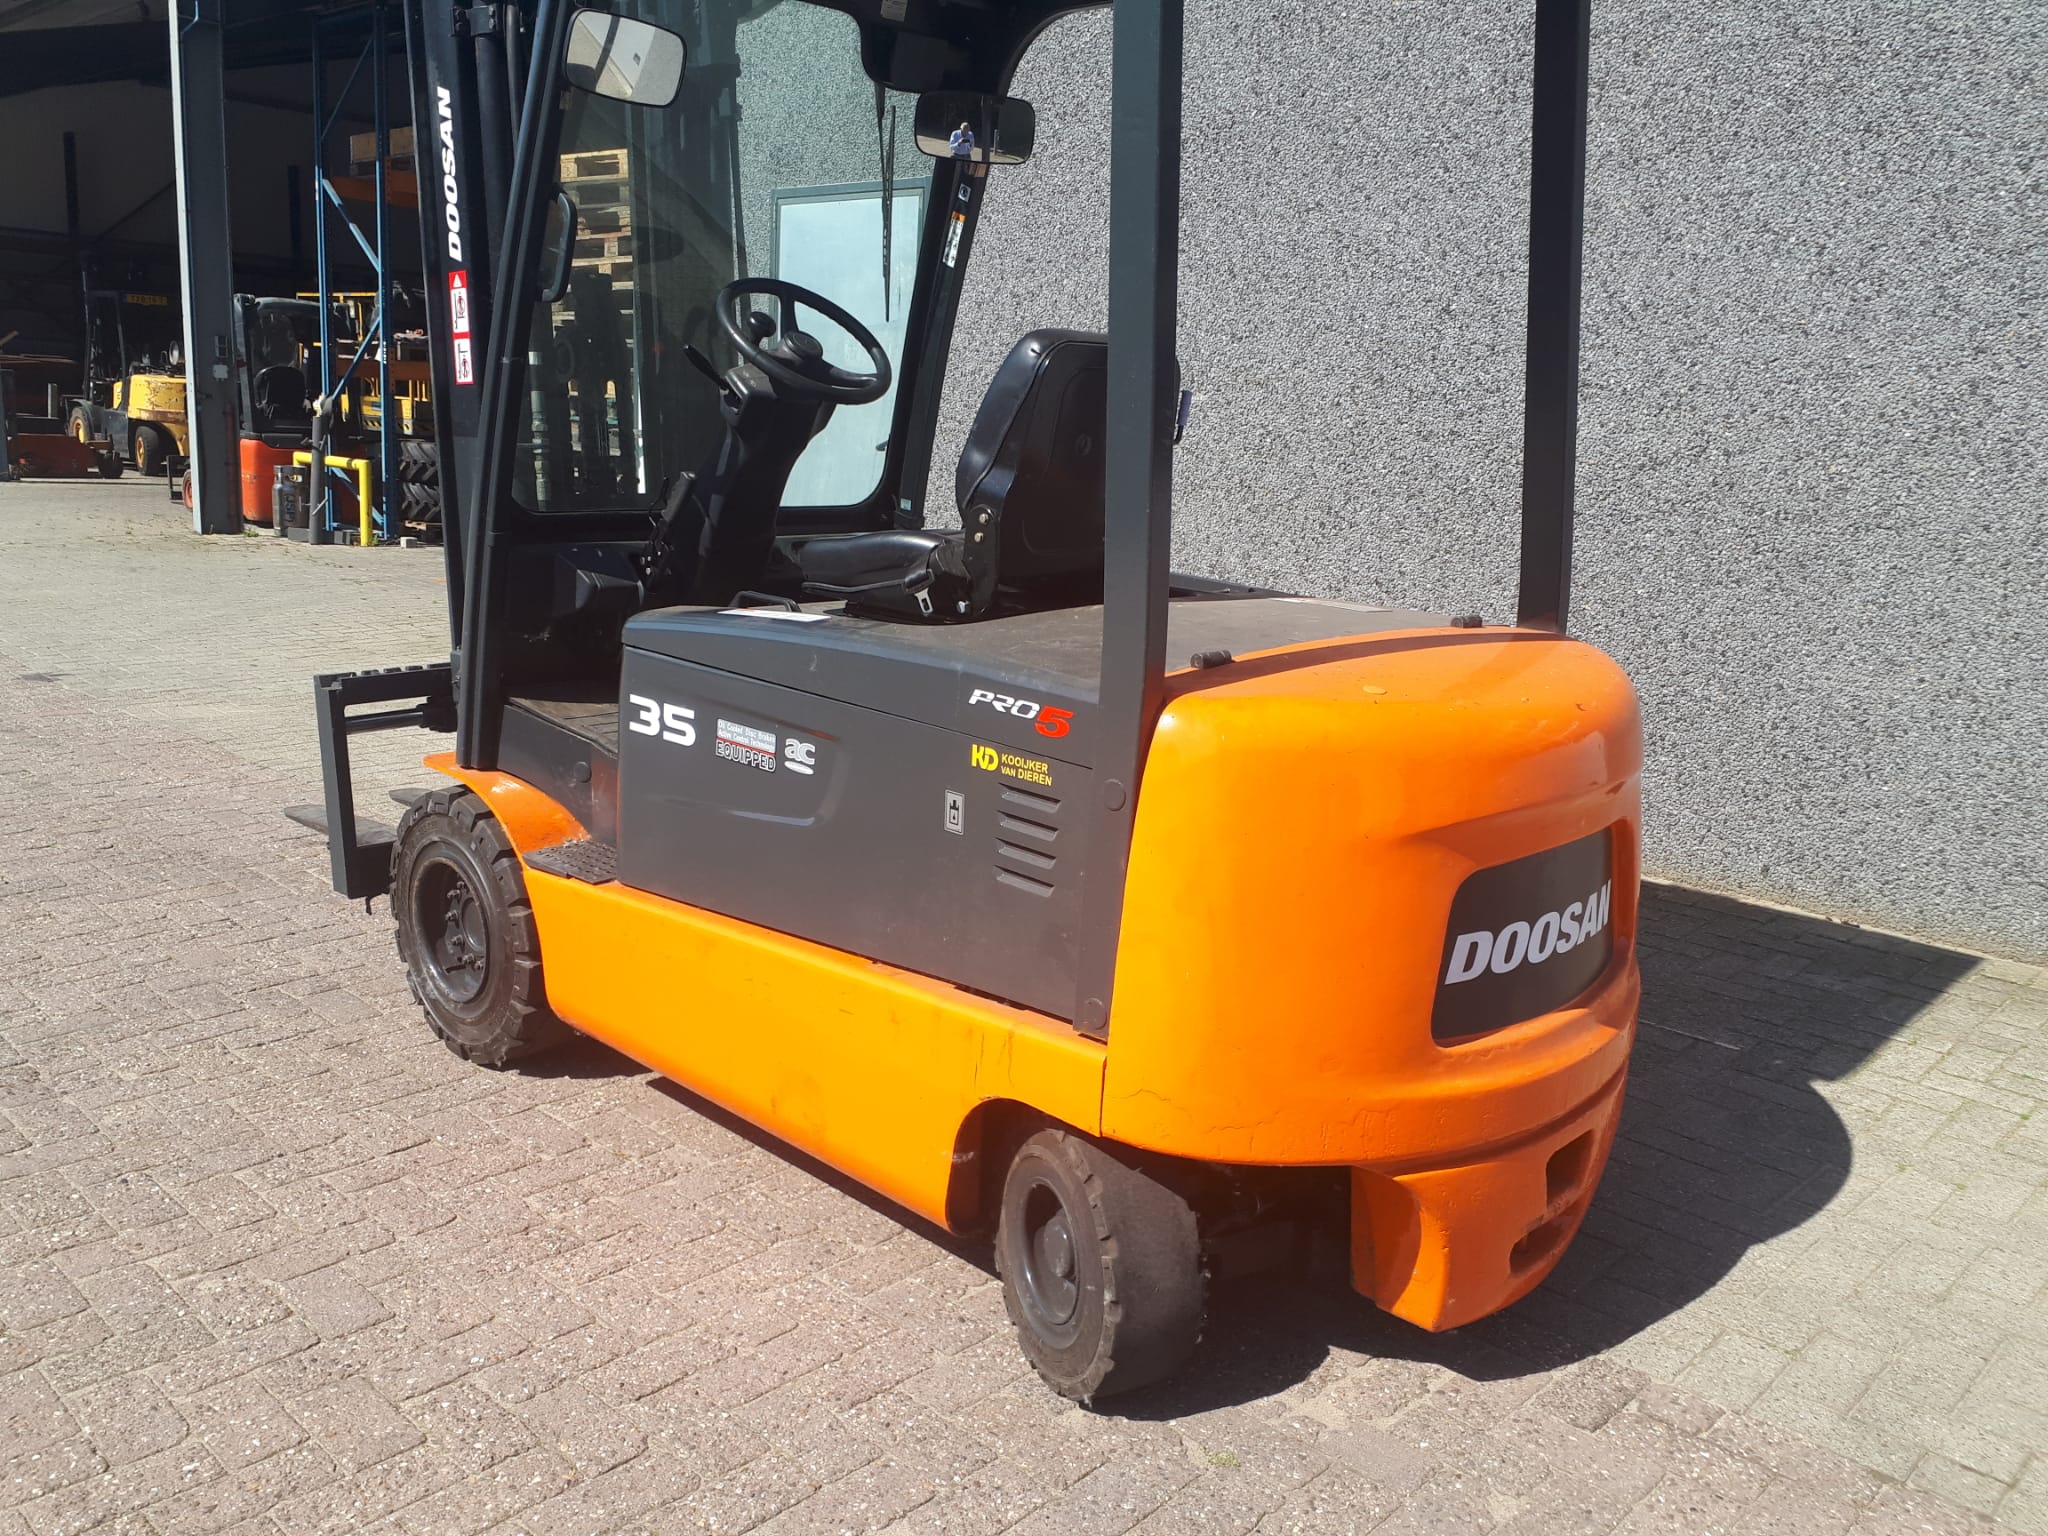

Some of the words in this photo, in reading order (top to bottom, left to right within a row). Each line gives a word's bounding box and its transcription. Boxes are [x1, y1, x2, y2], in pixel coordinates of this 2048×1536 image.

[437, 86, 462, 262] DOOSAN
[629, 693, 696, 747] 35
[716, 739, 776, 772] EQUIPPED
[785, 738, 816, 765] ac
[1001, 754, 1048, 773] KOOIJKER
[1001, 766, 1017, 777] VAN
[1017, 770, 1053, 786] DIEREN
[1444, 878, 1612, 985] DOOSAN
